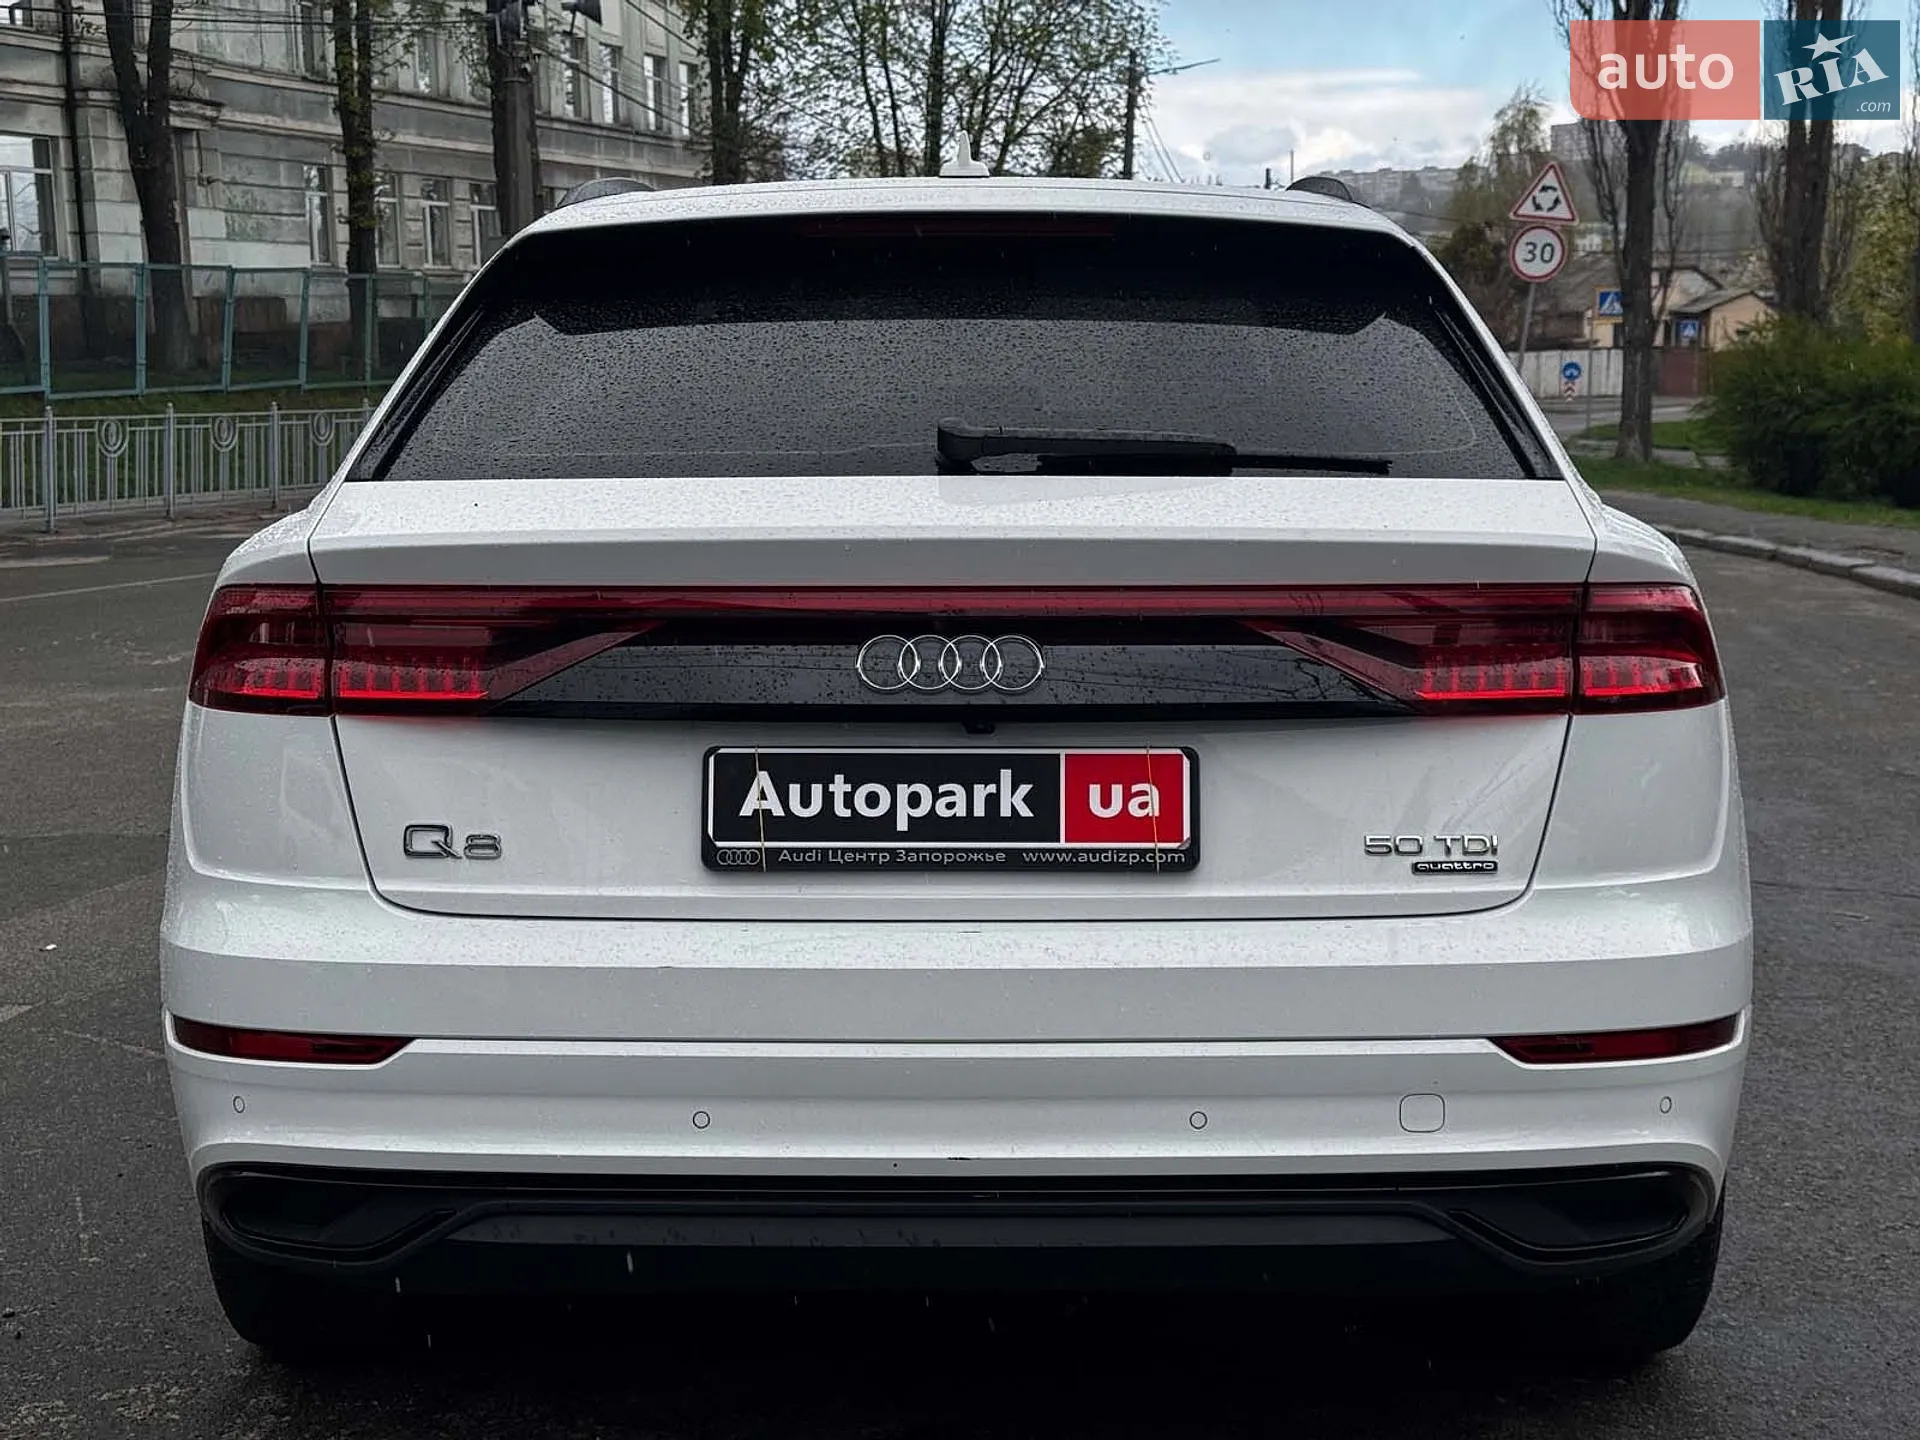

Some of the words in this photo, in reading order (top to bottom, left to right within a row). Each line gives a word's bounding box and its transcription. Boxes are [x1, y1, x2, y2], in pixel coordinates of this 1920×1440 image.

[1522, 241, 1555, 264] 30
[739, 769, 1035, 831] Autopark
[1088, 782, 1160, 818] ua
[403, 824, 502, 860] Q8
[1364, 835, 1423, 856] 50
[1433, 835, 1499, 857] TDI
[778, 849, 822, 863] Audi
[828, 849, 891, 865] Центр
[896, 849, 1007, 865] Запорожье
[1022, 850, 1185, 865] www.audizp.com
[1417, 861, 1495, 871] quattro
